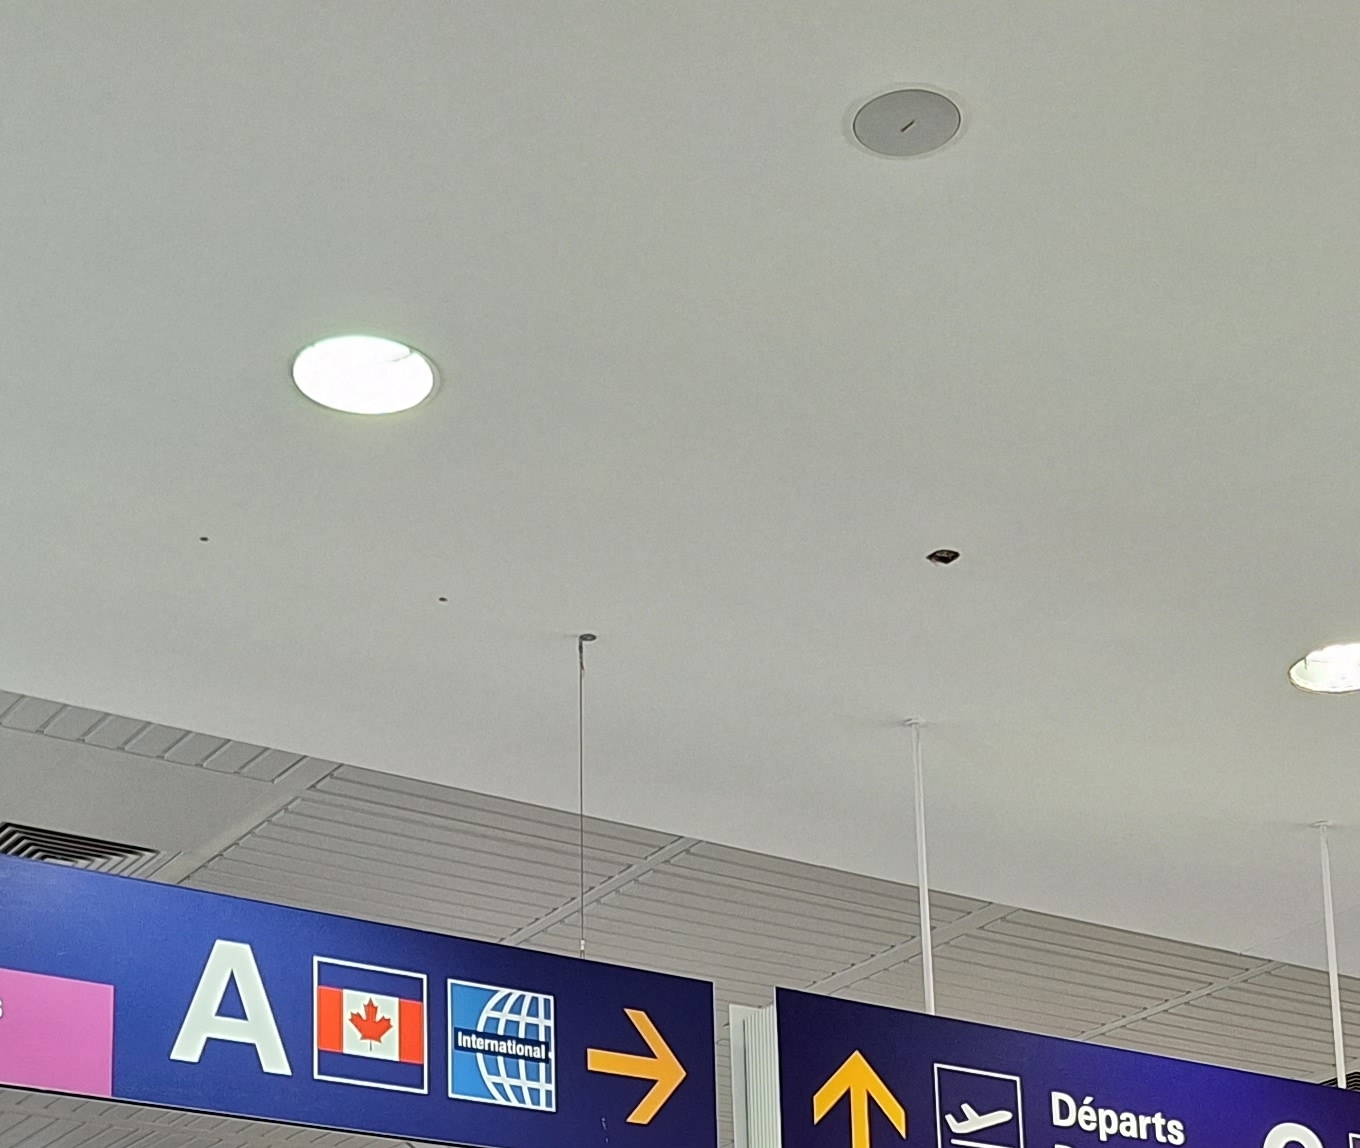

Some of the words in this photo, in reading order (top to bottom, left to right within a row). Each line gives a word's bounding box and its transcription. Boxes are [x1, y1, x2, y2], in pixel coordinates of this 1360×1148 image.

[168, 939, 293, 1078] A
[457, 1031, 546, 1060] International
[1050, 1090, 1187, 1148] Départs
